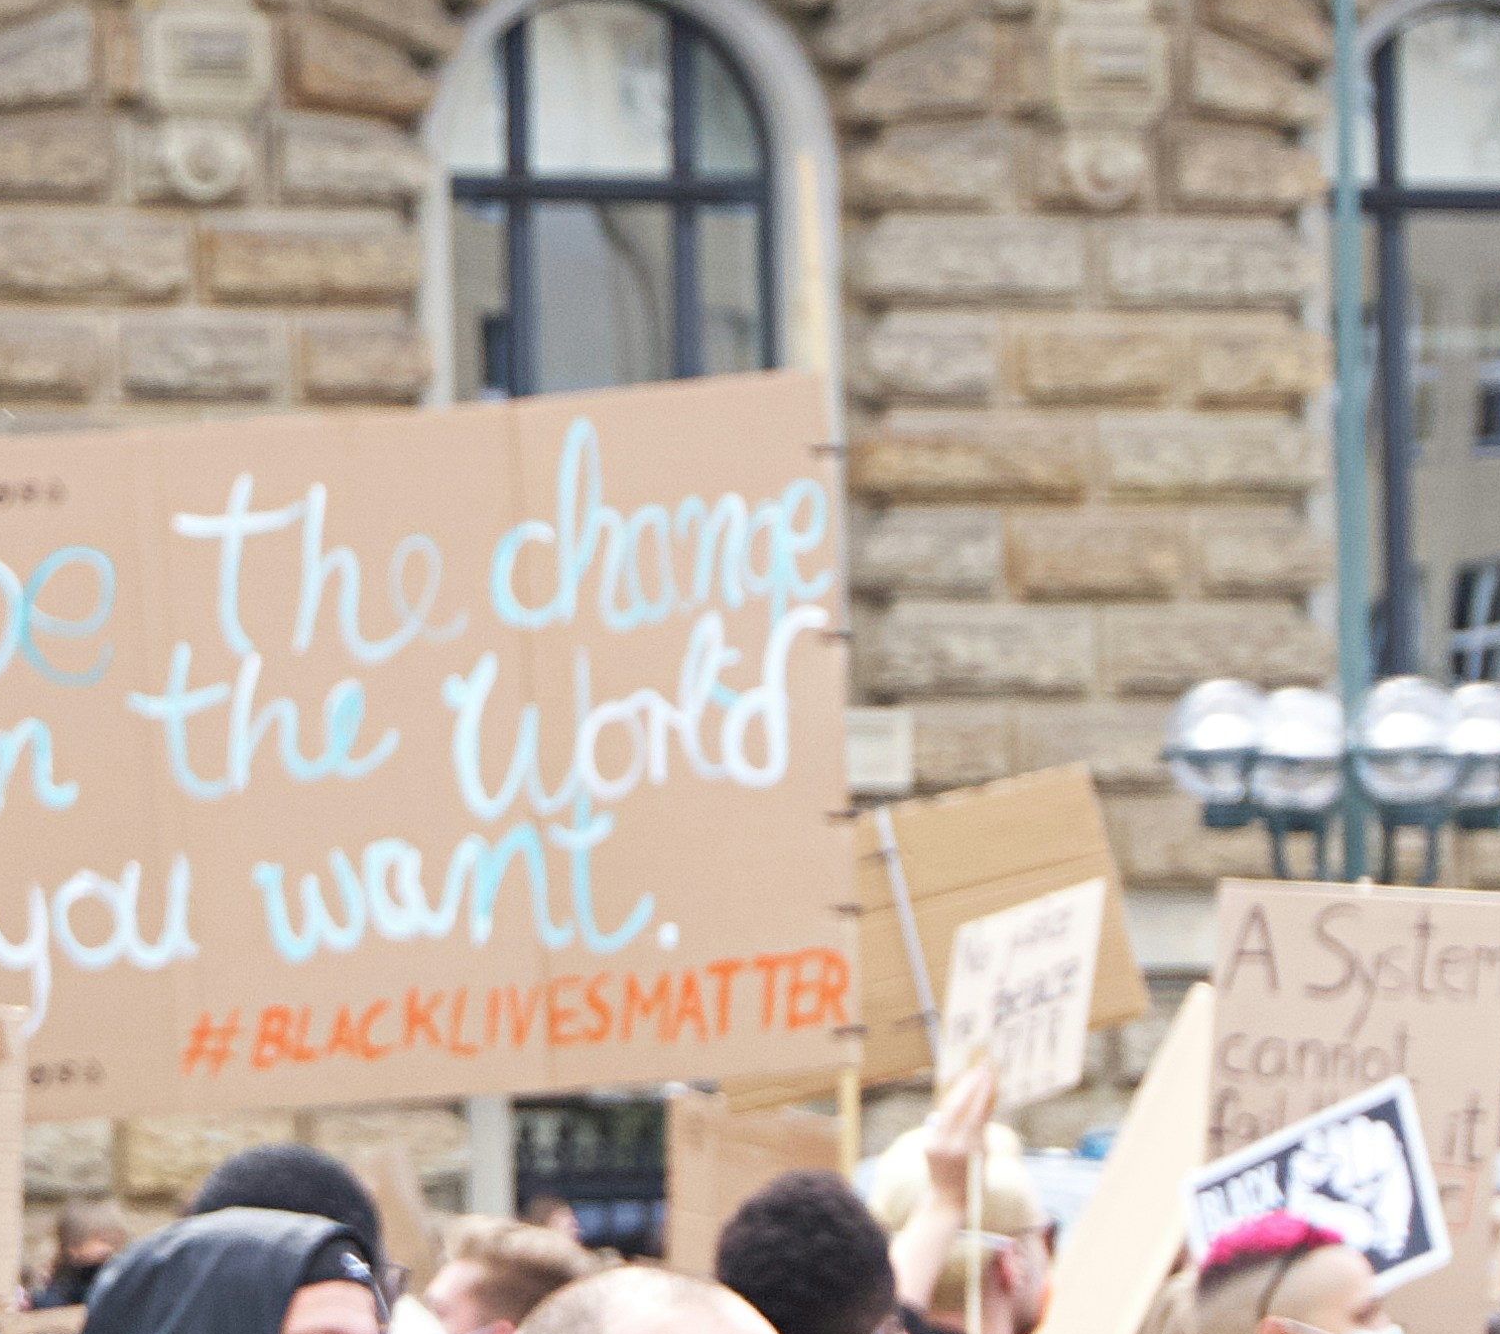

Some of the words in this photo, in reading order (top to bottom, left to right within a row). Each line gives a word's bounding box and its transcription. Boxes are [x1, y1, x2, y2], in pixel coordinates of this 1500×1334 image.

[489, 415, 836, 631] change
[253, 810, 682, 964] want.
[1219, 902, 1279, 995] A
[181, 945, 852, 1078] #BLACKLIVESMATTER
[1216, 1022, 1421, 1084] cannot
